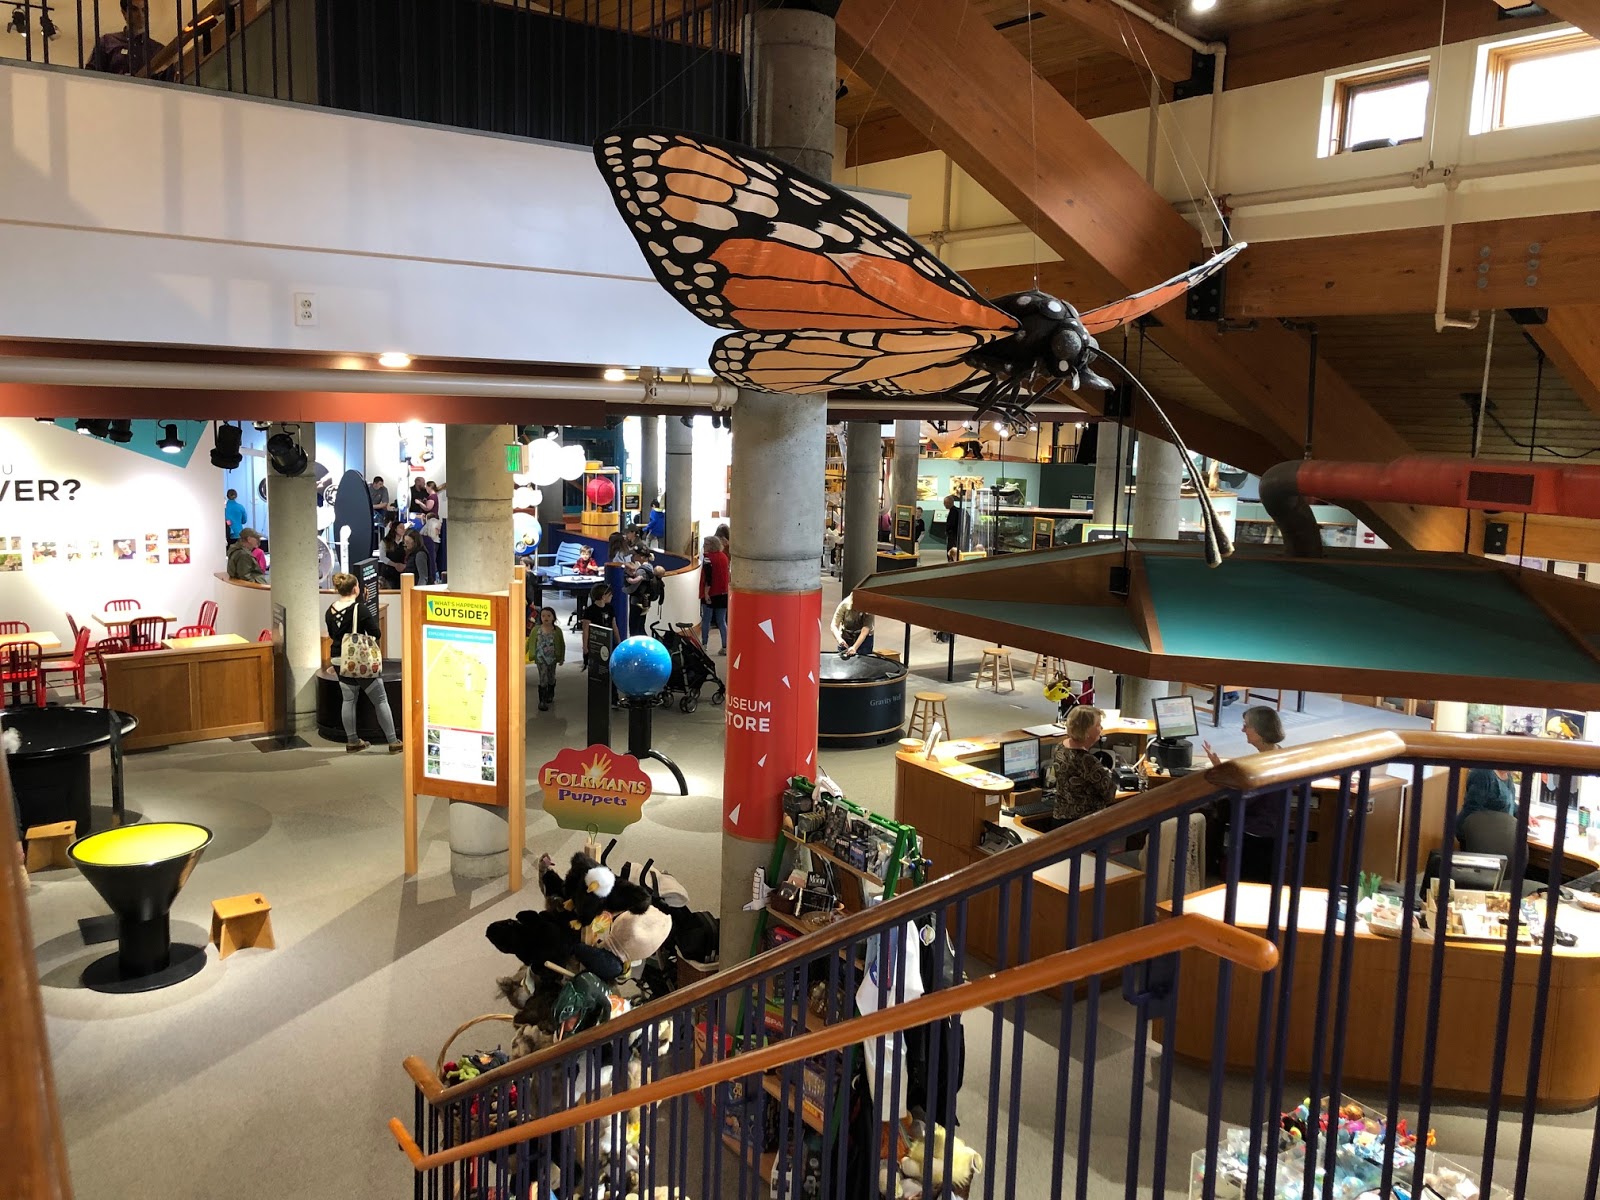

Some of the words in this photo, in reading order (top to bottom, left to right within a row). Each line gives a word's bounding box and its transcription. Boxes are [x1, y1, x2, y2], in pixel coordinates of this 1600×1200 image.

[434, 607, 489, 620] OUTSIDE?
[455, 602, 488, 610] HAPPENING
[544, 768, 647, 796] FOLKMANIS
[558, 788, 628, 807] Puppets
